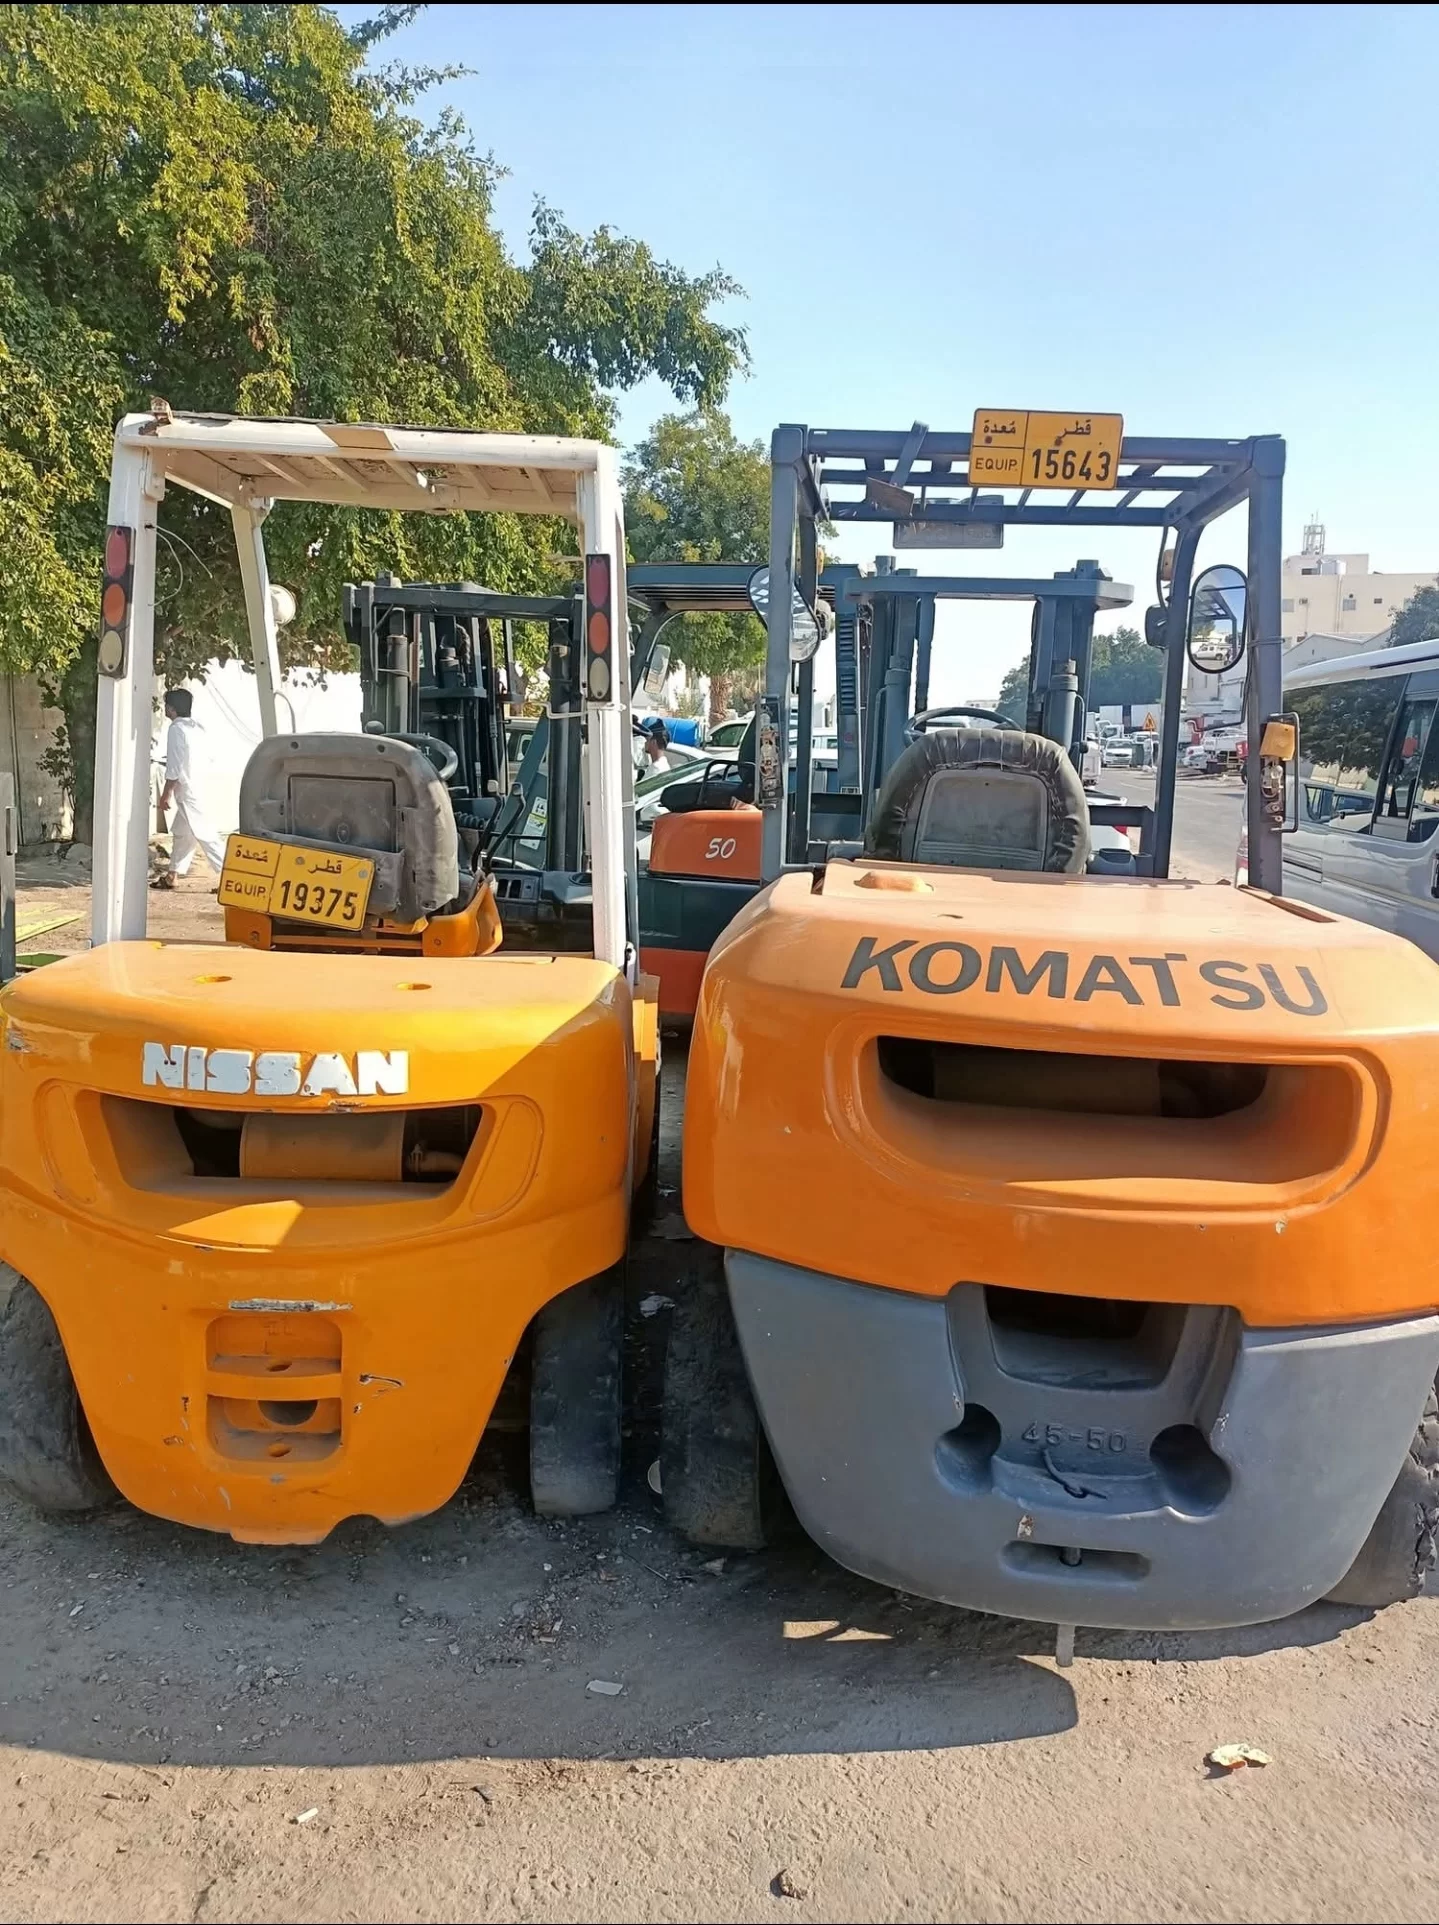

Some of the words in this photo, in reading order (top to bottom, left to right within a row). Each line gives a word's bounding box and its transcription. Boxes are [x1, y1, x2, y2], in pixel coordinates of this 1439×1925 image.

[1059, 419, 1092, 438] قطر
[975, 457, 1018, 471] EQUIP.
[1032, 448, 1111, 482] 15643
[705, 838, 736, 859] 50
[308, 859, 342, 874] قطر
[225, 880, 266, 898] EQUIP.
[281, 880, 358, 921] 19375
[840, 936, 1329, 1016] KOMATSU
[142, 1041, 409, 1096] NISSAN
[1022, 1420, 1126, 1453] 45-50
